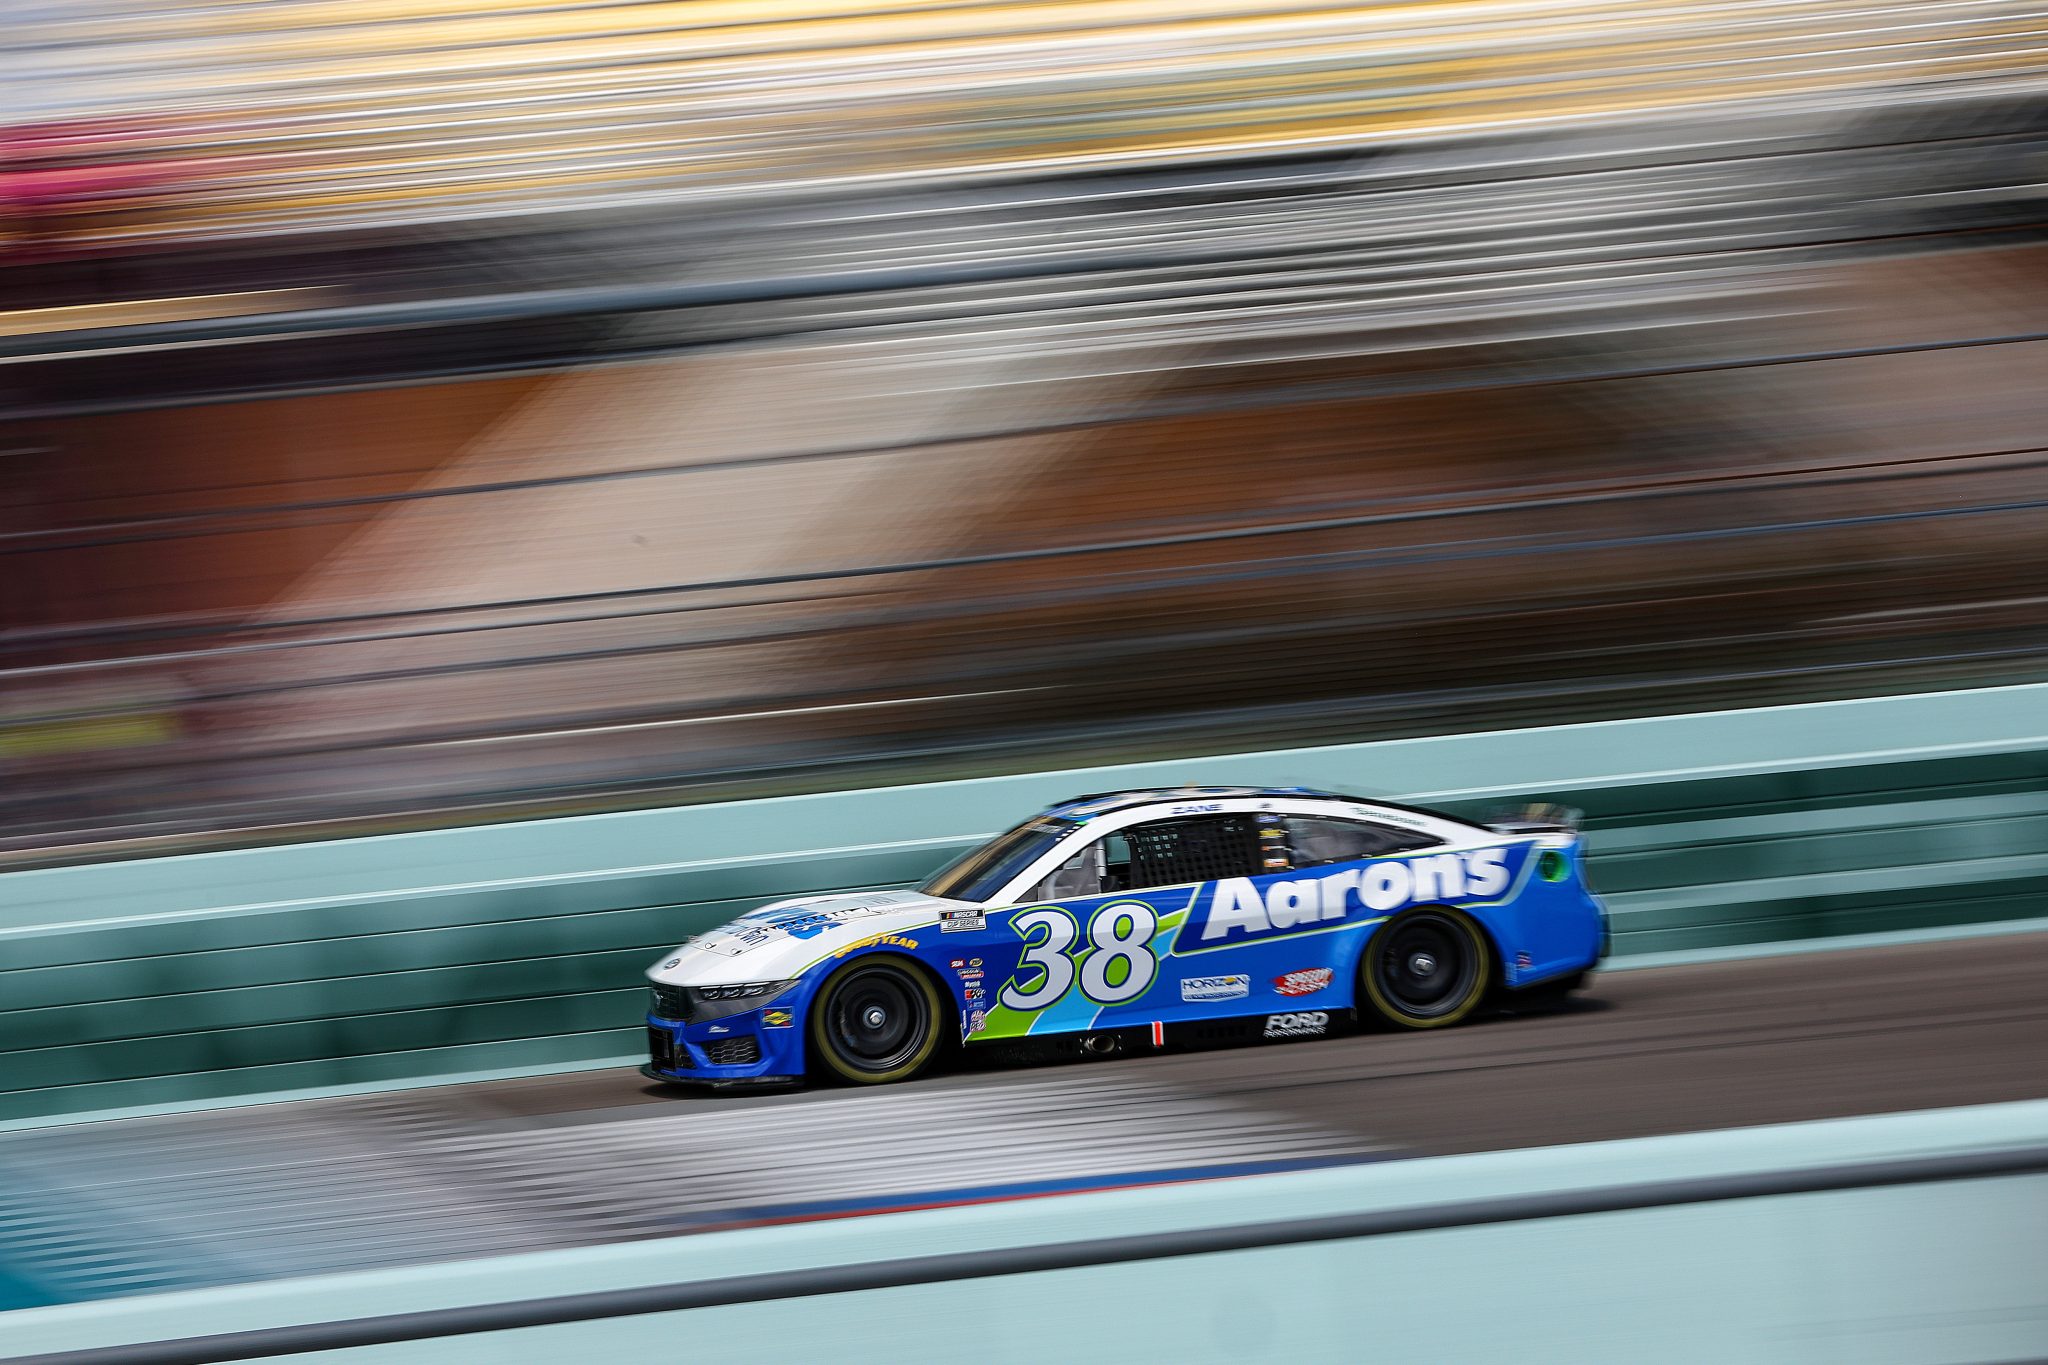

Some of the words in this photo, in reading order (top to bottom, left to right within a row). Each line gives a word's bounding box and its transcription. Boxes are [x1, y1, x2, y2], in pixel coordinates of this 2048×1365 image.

[1171, 804, 1223, 814] ZANE
[1201, 848, 1511, 940] Aaron's
[953, 910, 978, 918] NASCAR
[960, 919, 979, 927] SERIES
[998, 901, 1159, 1010] 38
[1183, 976, 1248, 994] HORIZON
[1265, 1011, 1330, 1031] FORD
